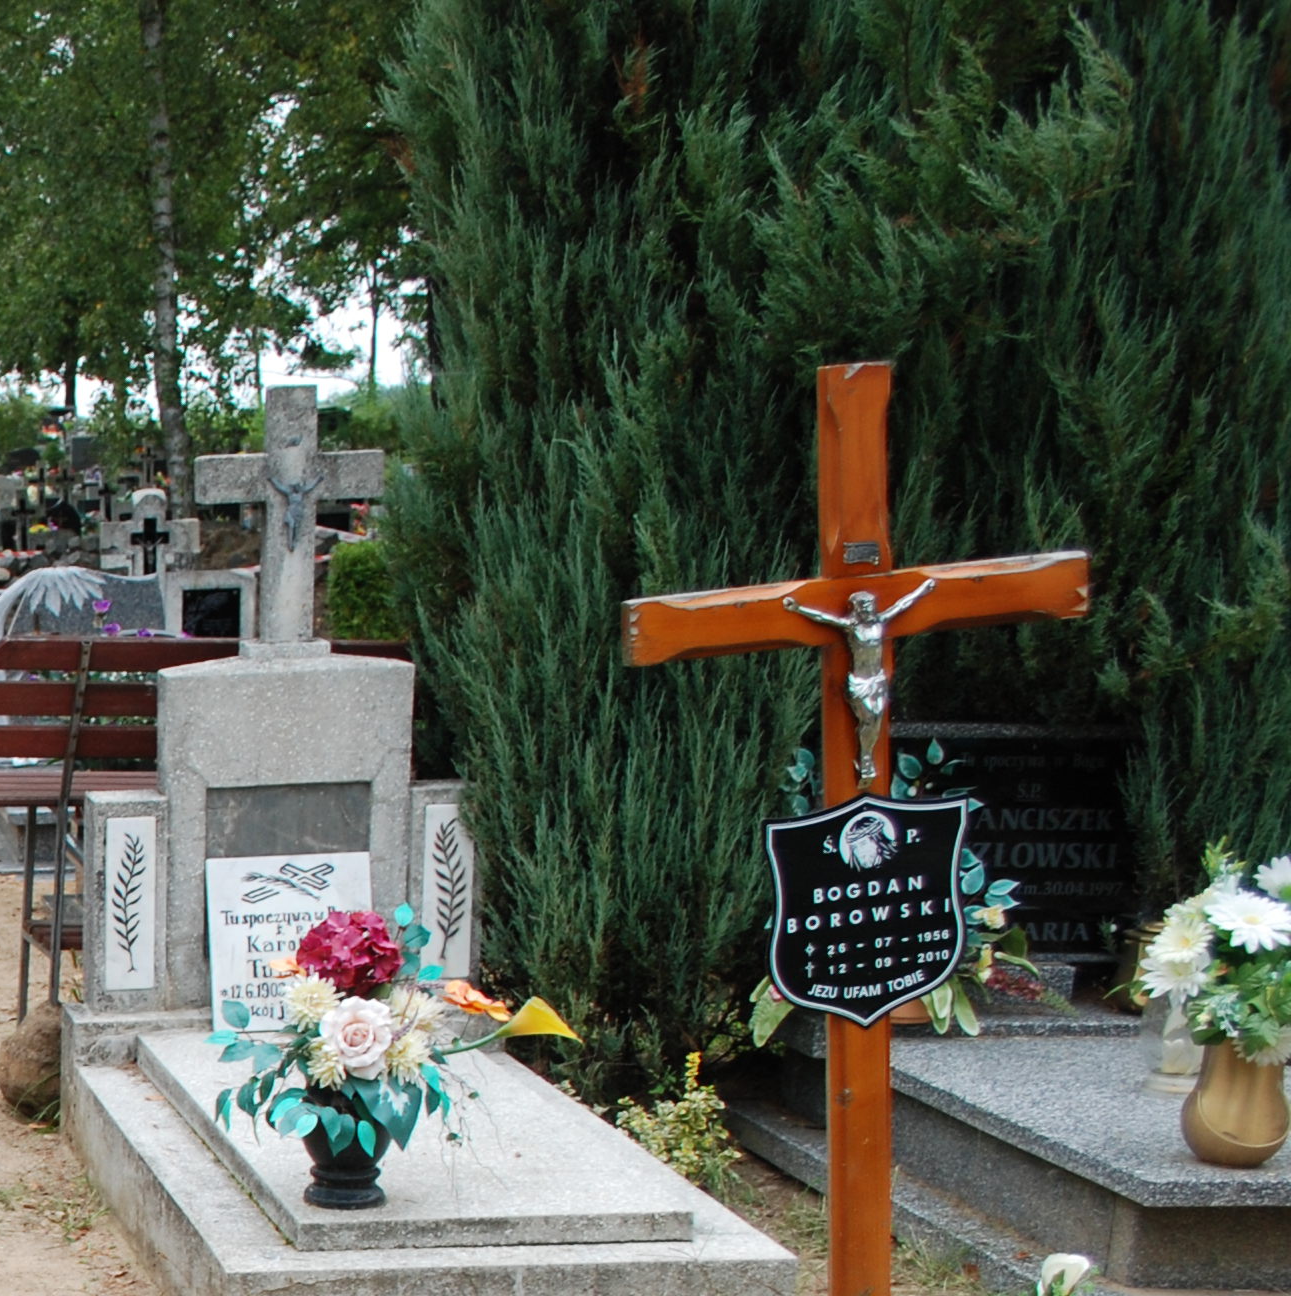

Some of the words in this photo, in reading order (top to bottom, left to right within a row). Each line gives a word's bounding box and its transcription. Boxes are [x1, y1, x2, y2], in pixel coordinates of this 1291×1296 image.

[973, 808, 1115, 831] ANCISZEK
[906, 829, 921, 844] P.
[971, 841, 1119, 869] ZŁOWSKI
[813, 875, 923, 904] BOGDAN
[220, 910, 239, 926] Tu
[786, 898, 950, 934] BOROWSKI
[1023, 921, 1090, 942] ARIA
[807, 983, 838, 999] JEZU
[843, 983, 882, 999] UFAM
[886, 969, 926, 993] TOBIE
